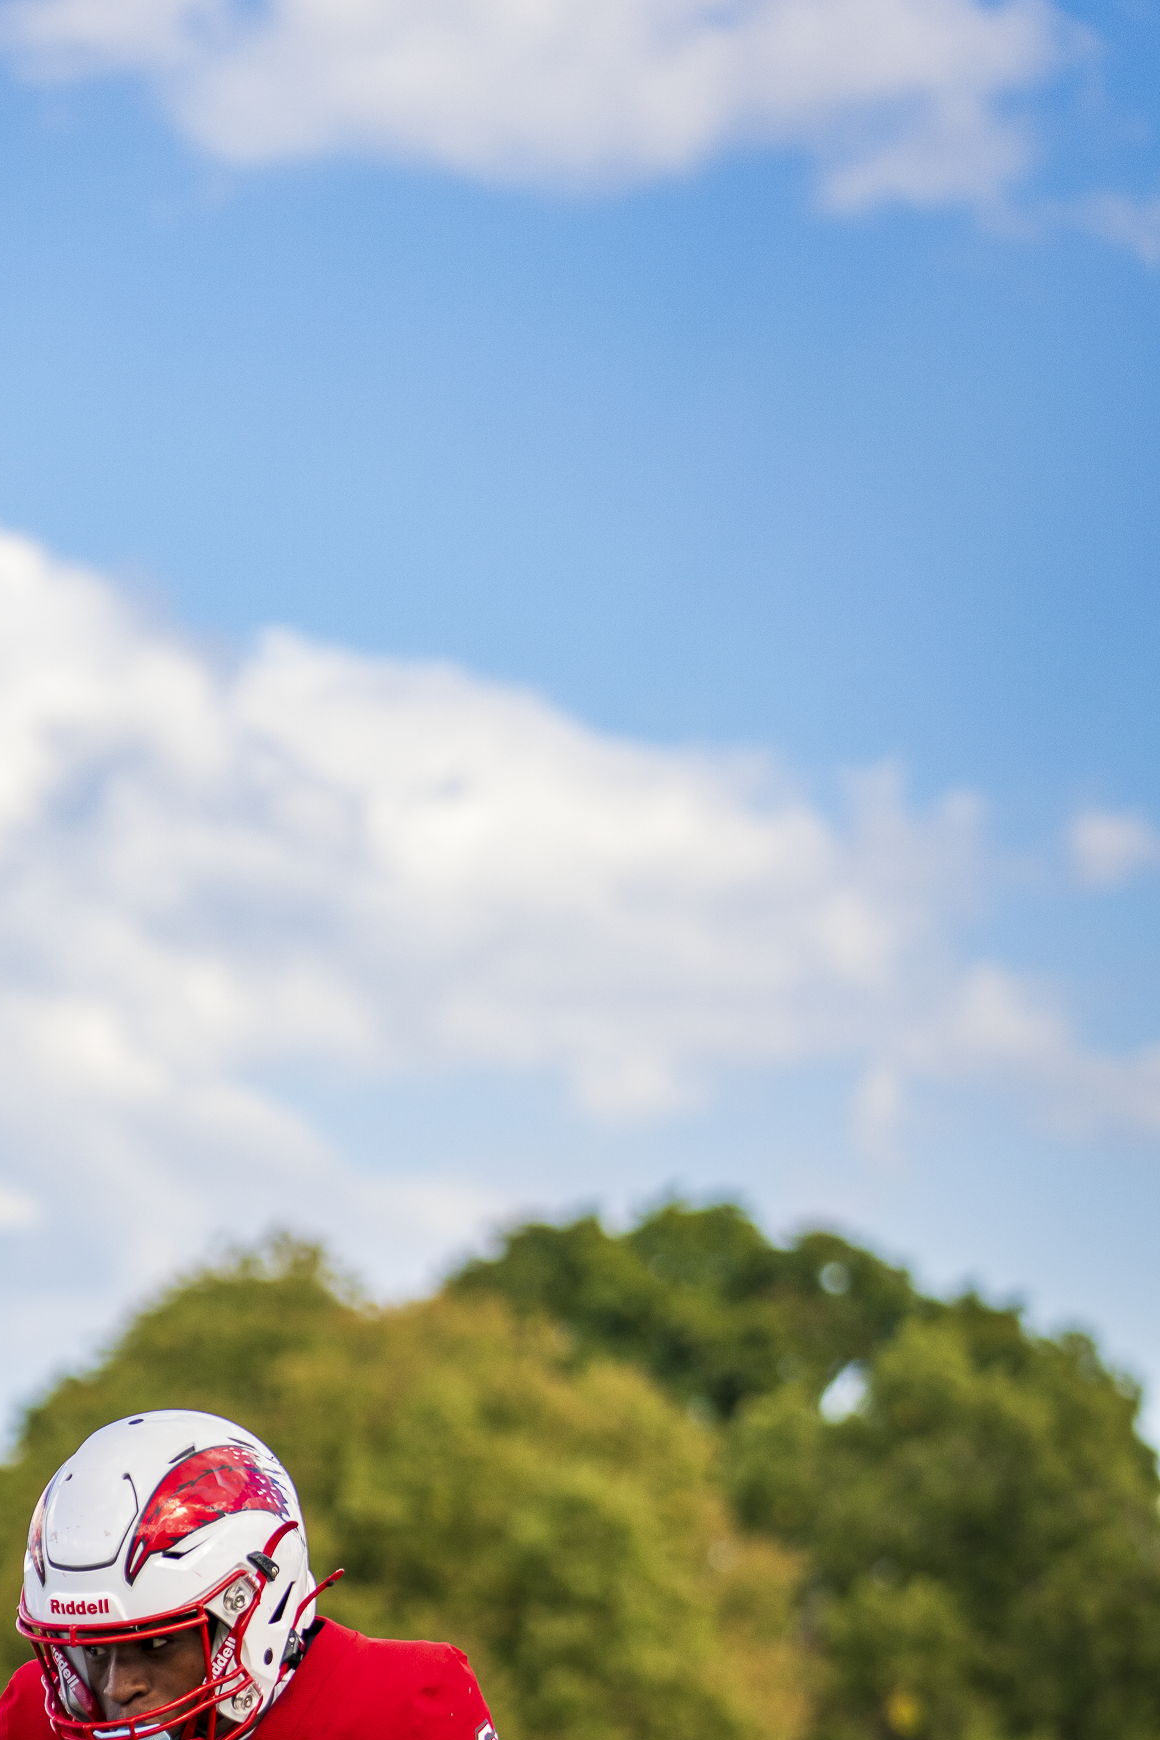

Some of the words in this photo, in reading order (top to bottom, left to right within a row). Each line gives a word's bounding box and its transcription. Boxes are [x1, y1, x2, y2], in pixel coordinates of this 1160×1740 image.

[49, 1598, 110, 1616] Riddell
[51, 1646, 80, 1689] ddell
[201, 1635, 237, 1686] ddell
